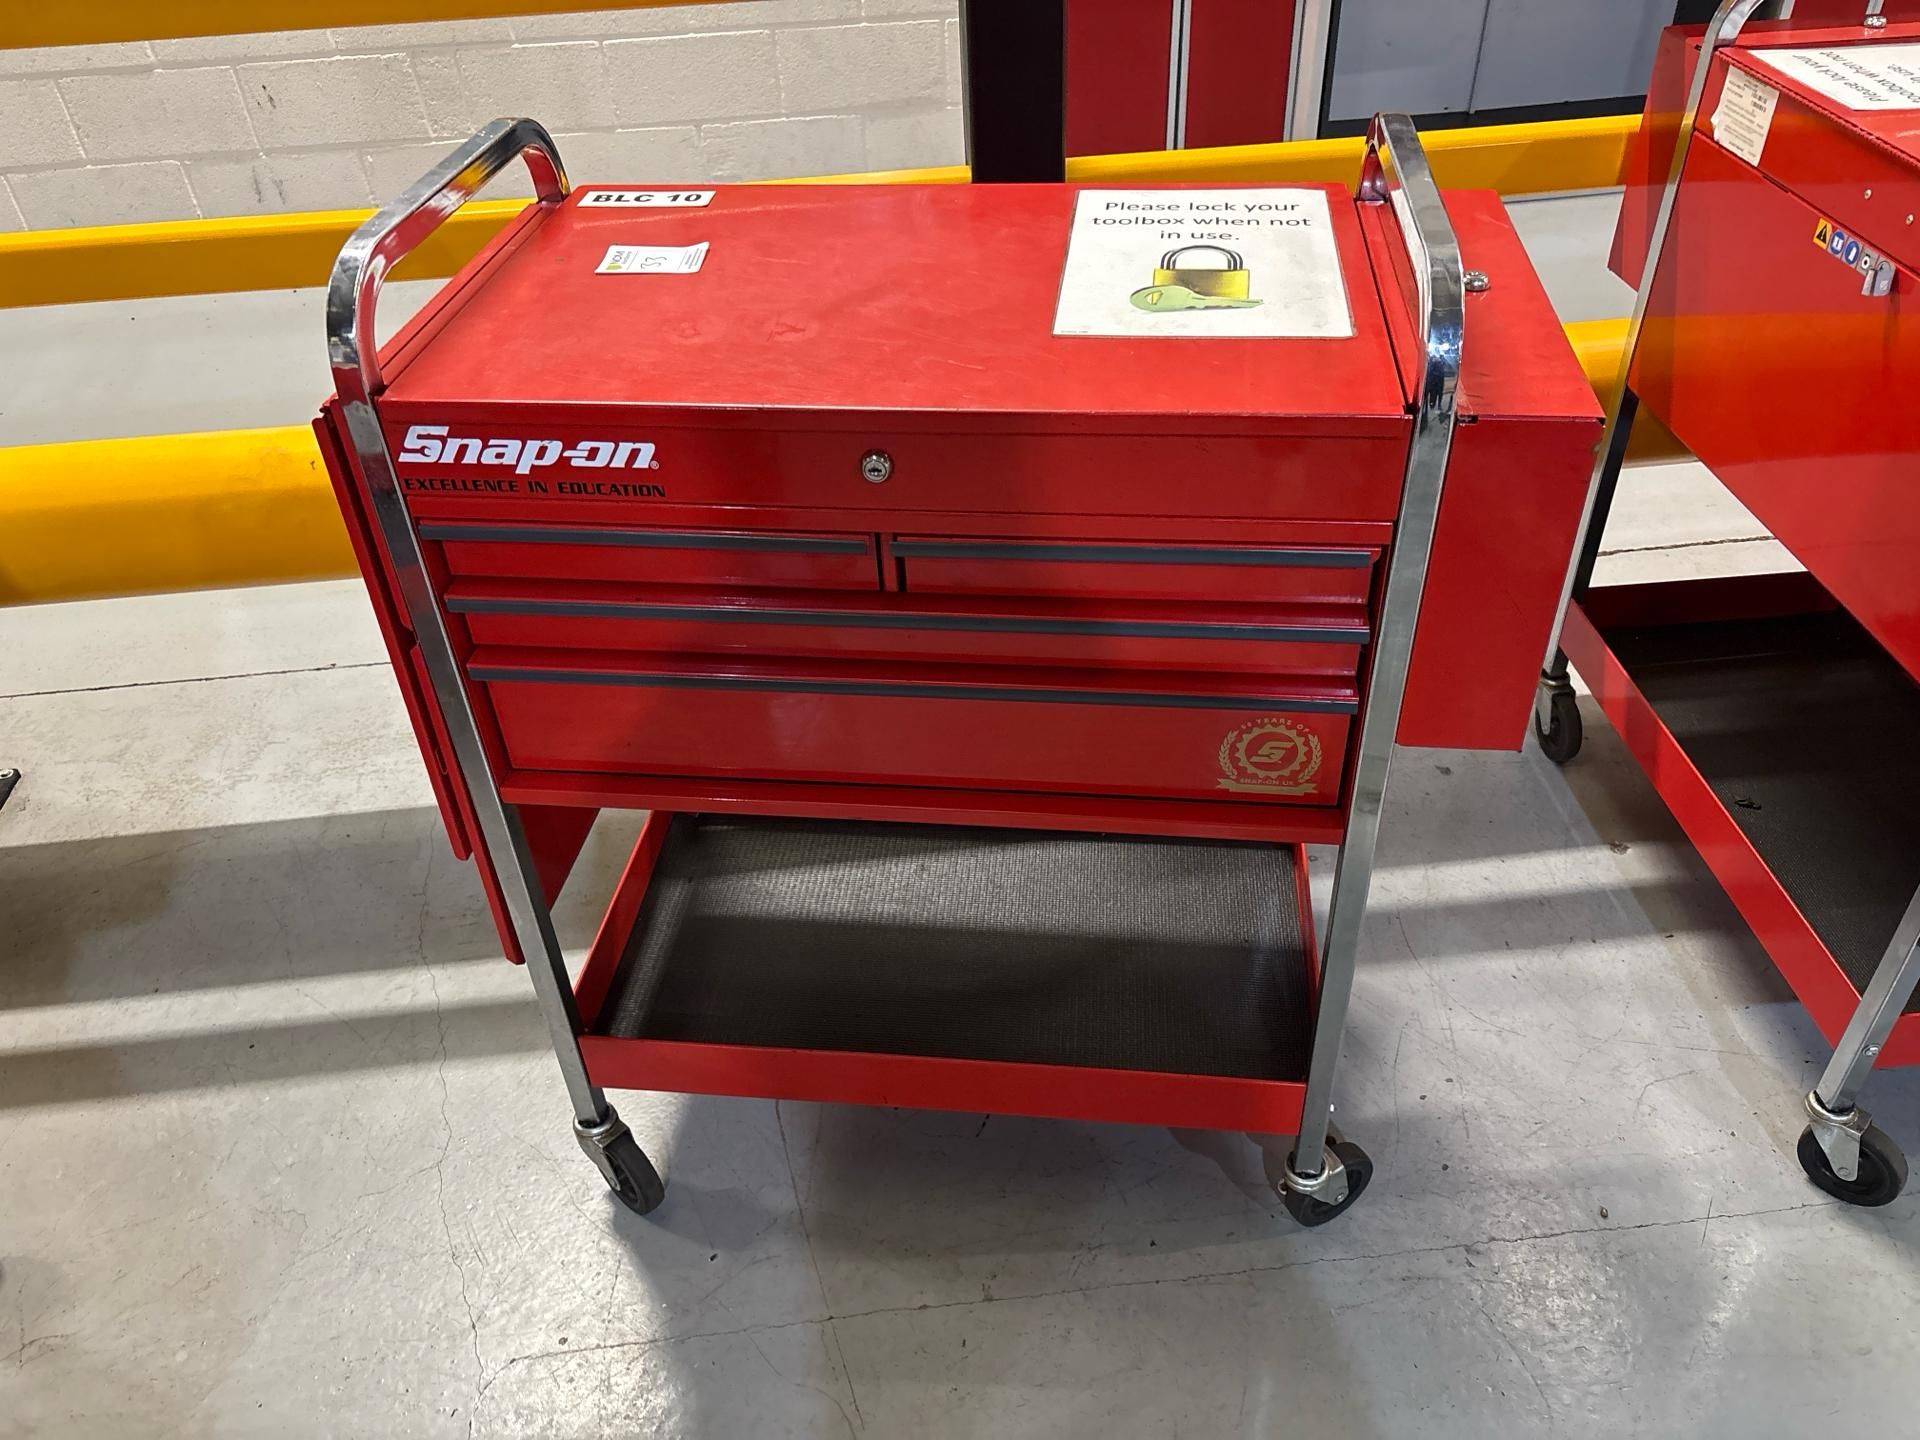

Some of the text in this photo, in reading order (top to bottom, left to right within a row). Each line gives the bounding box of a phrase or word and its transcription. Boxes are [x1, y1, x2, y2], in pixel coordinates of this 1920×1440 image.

[1792, 55, 1888, 101] Please lock your
[592, 193, 703, 203] BLC 10
[1105, 202, 1300, 213] Please lock your
[1093, 216, 1312, 227] toolbox when not
[1160, 230, 1240, 240] in use.
[404, 478, 666, 498] EXCELLENCE IN EDUCATION
